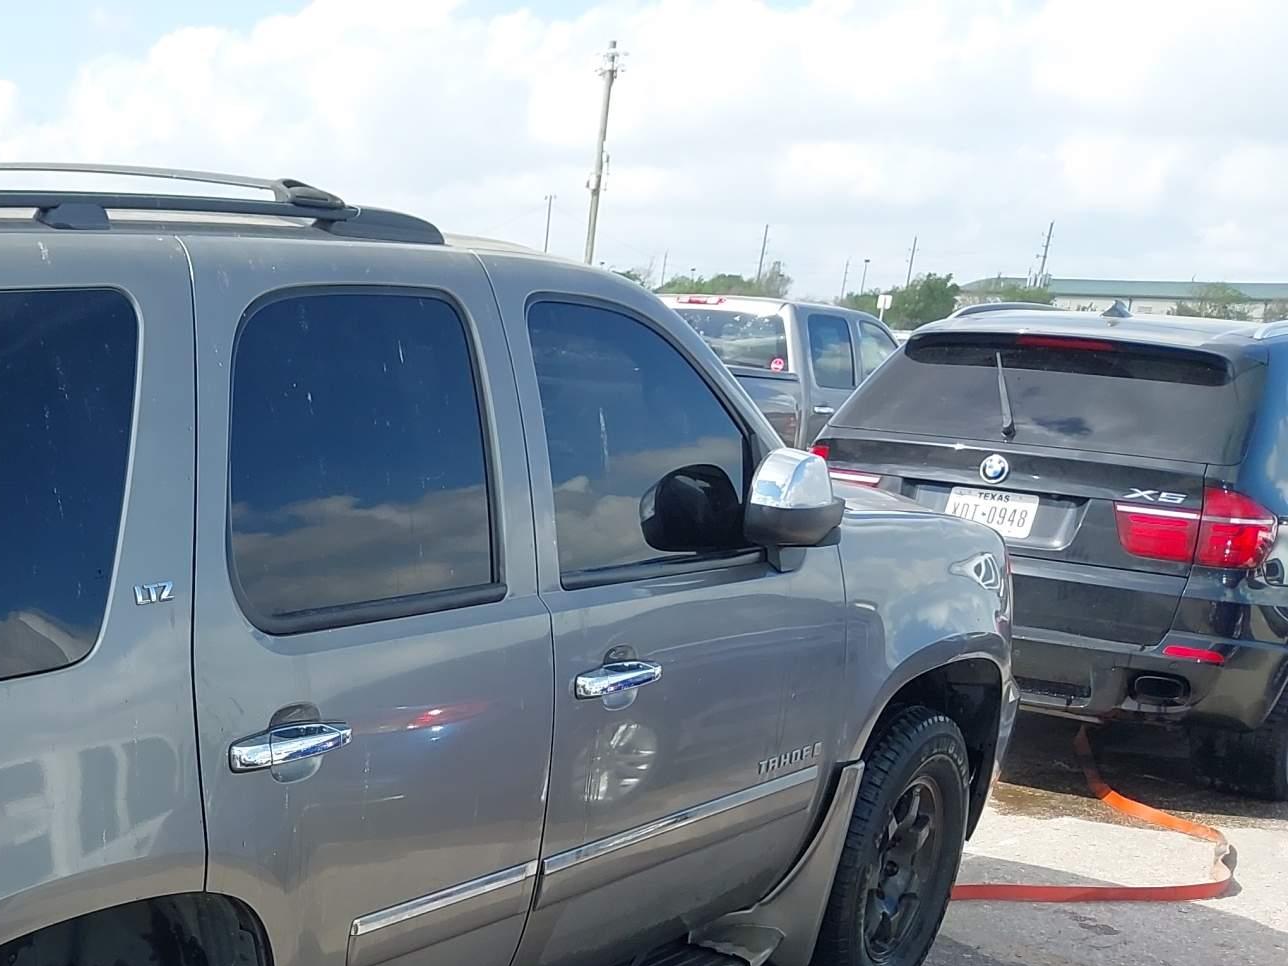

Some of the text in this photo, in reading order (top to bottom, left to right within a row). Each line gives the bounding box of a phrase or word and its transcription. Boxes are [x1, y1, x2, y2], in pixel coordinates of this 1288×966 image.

[978, 491, 1011, 503] TEXAS
[1122, 487, 1188, 504] X5
[134, 581, 175, 605] LTZ
[758, 745, 813, 775] TAHOE
